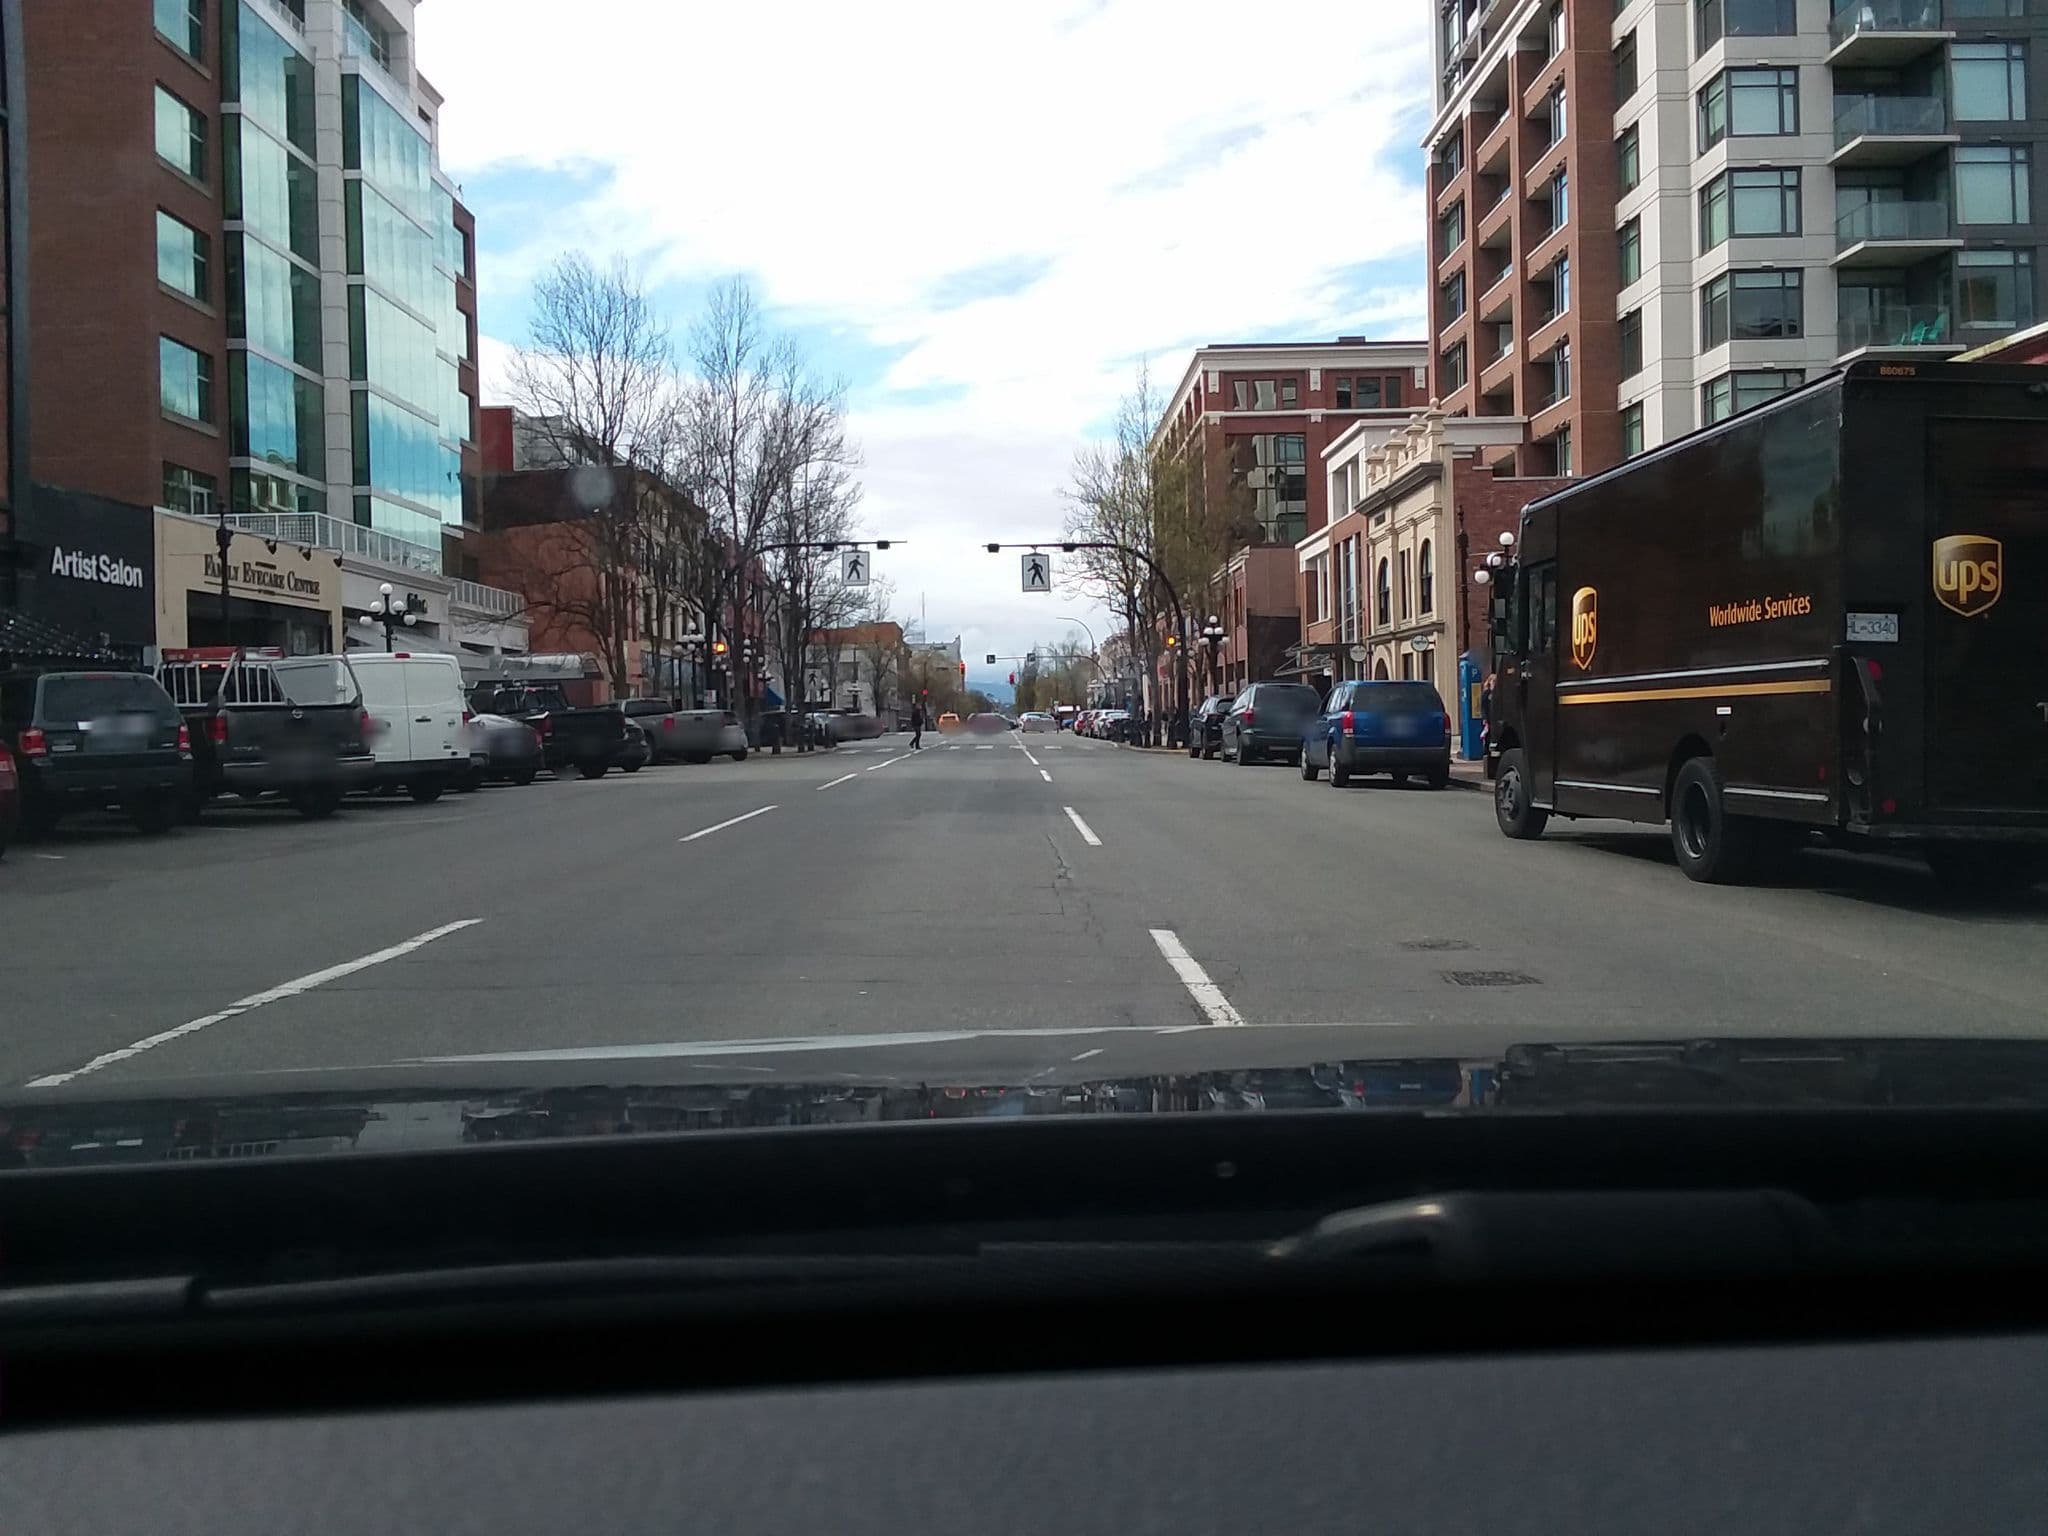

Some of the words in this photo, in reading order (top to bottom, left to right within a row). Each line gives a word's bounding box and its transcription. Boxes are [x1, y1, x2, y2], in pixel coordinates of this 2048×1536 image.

[51, 545, 98, 581] Artist
[99, 554, 143, 588] Salon
[204, 554, 240, 581] FAMLY
[1938, 560, 1998, 605] ups
[1709, 598, 1762, 627] Worldwide
[1763, 592, 1811, 620] Services
[1574, 610, 1596, 658] ups
